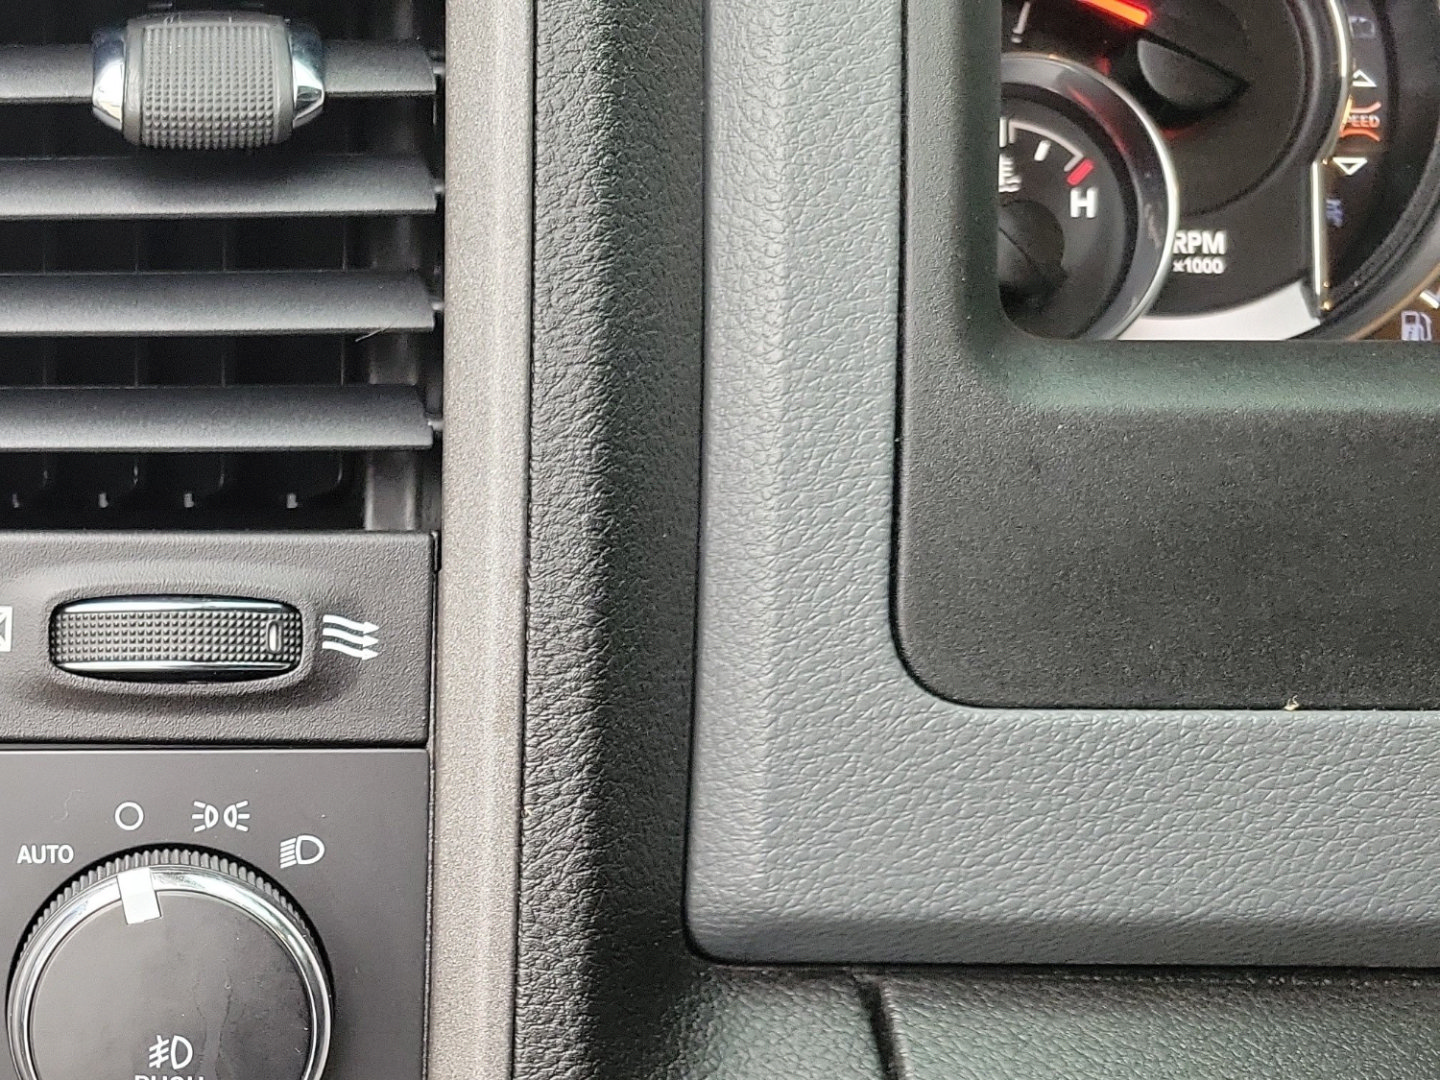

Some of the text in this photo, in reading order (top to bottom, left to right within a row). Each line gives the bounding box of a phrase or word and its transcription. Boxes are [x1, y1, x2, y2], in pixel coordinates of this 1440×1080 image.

[1070, 188, 1097, 219] H
[1172, 231, 1226, 254] RPM
[1173, 257, 1224, 274] x1000
[16, 844, 75, 864] AUTO
